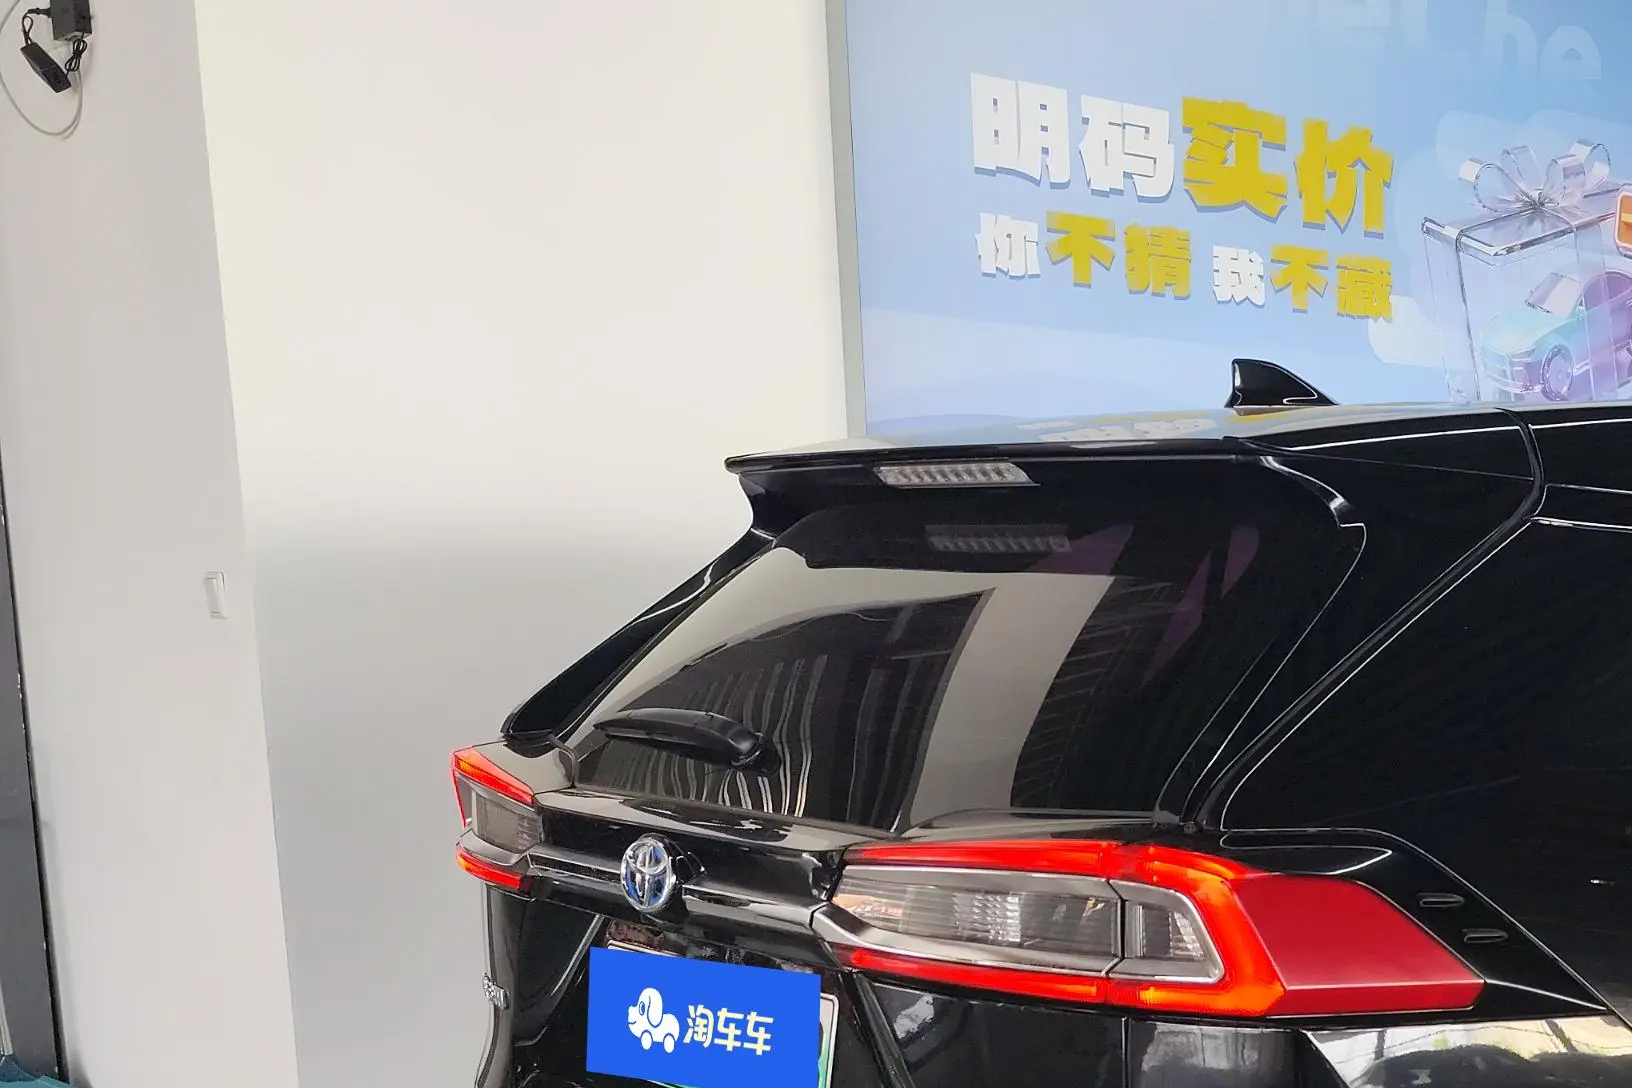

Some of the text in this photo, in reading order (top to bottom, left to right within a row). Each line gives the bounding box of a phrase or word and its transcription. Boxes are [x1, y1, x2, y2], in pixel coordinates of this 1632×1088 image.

[970, 72, 1395, 238] 明码实价
[975, 211, 1394, 323] 你不猜 我不藏
